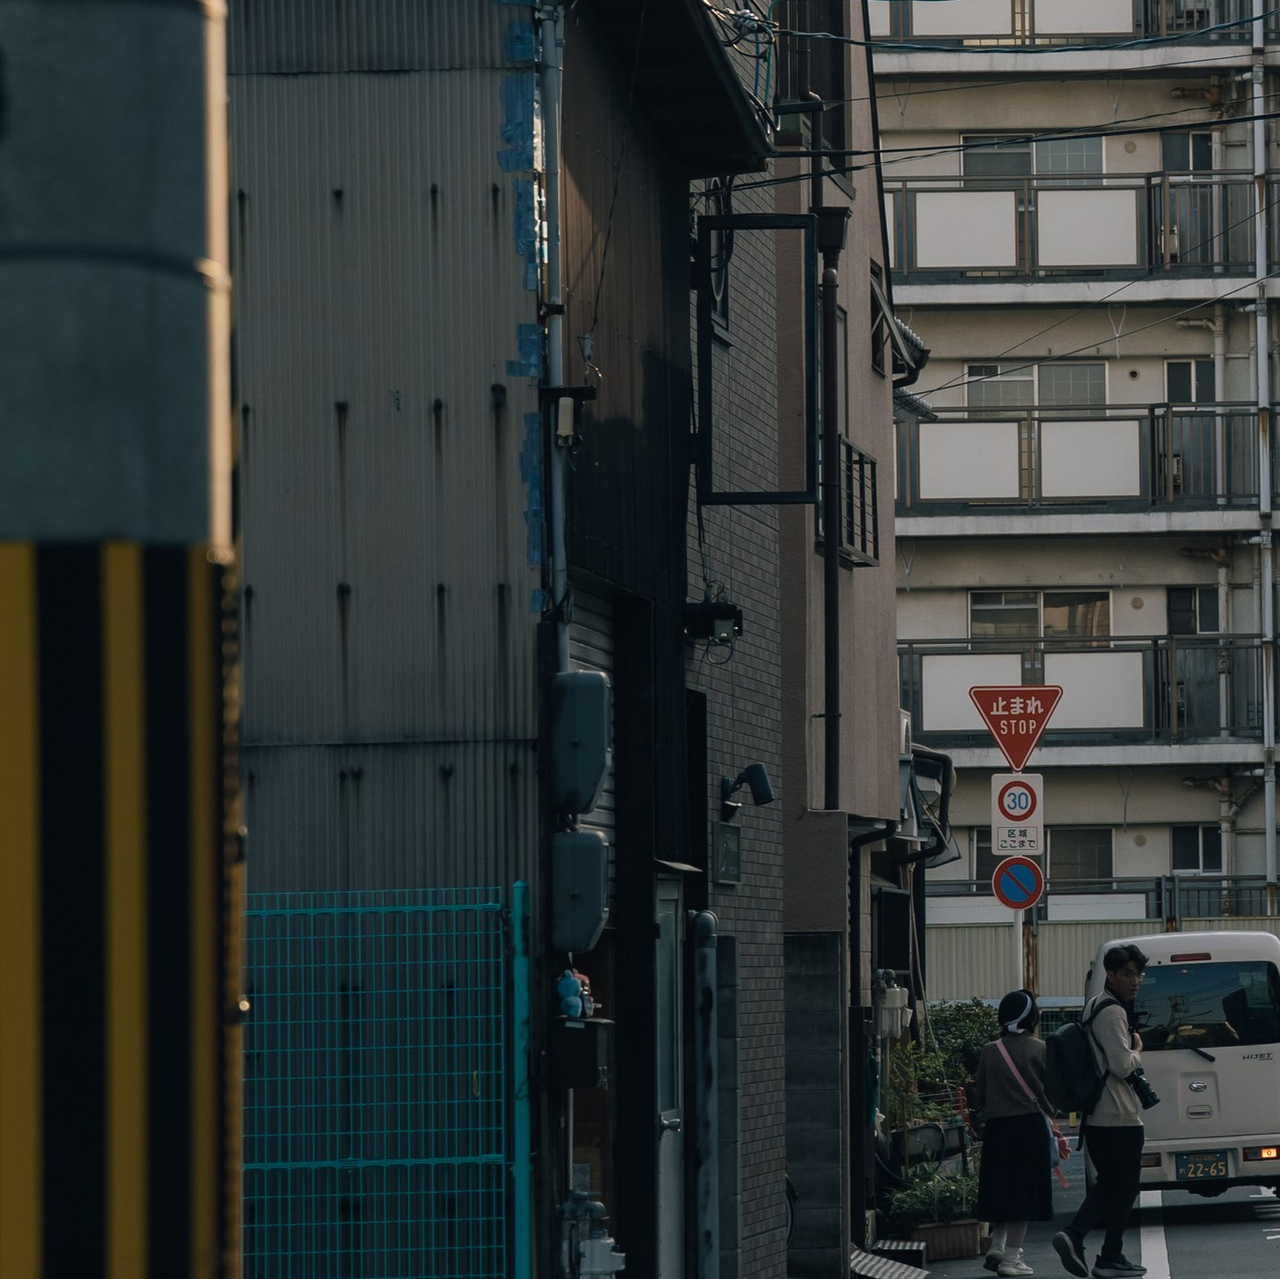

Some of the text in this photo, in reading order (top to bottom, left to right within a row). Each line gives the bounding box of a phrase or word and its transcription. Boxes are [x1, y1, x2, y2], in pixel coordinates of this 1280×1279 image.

[990, 696, 1044, 715] 止まれ
[999, 720, 1036, 735] STOP
[1007, 792, 1029, 810] 30
[1000, 839, 1036, 849] ここまで
[1242, 1052, 1273, 1061] HIJET
[1187, 1161, 1226, 1178] 22-65
